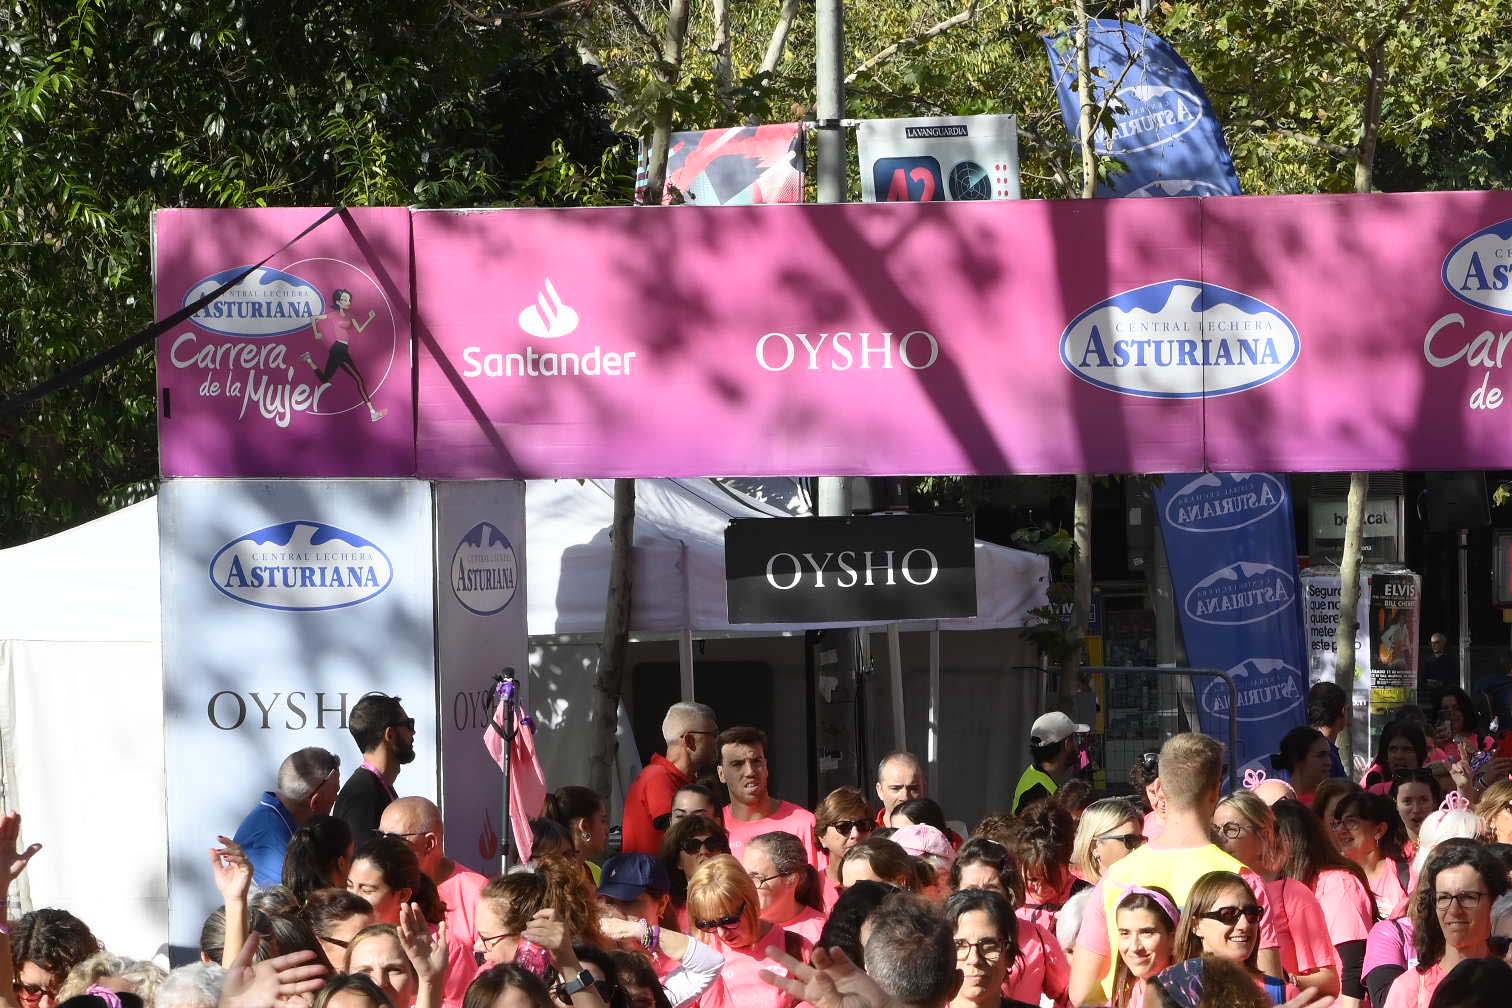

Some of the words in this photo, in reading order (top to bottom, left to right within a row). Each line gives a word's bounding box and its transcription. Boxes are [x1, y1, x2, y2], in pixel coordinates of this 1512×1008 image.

[1114, 317, 1195, 333] CENTRAL
[1199, 317, 1275, 333] LECHERA
[169, 331, 288, 371] Carrera
[463, 345, 637, 377] Santander
[755, 331, 940, 372] OYSHO
[1080, 324, 1281, 368] ASTURIANA
[199, 374, 223, 397] de
[224, 370, 242, 397] la
[238, 365, 333, 428] Mujer
[1468, 369, 1505, 411] de
[224, 554, 379, 588] ASTURIANA
[251, 551, 312, 562] CENTRAL
[315, 551, 374, 562] LECHERA
[456, 556, 515, 592] ASTURIANA
[765, 548, 939, 590] OYSHO
[1384, 583, 1415, 596] ELVIS
[206, 689, 394, 732] OYSH
